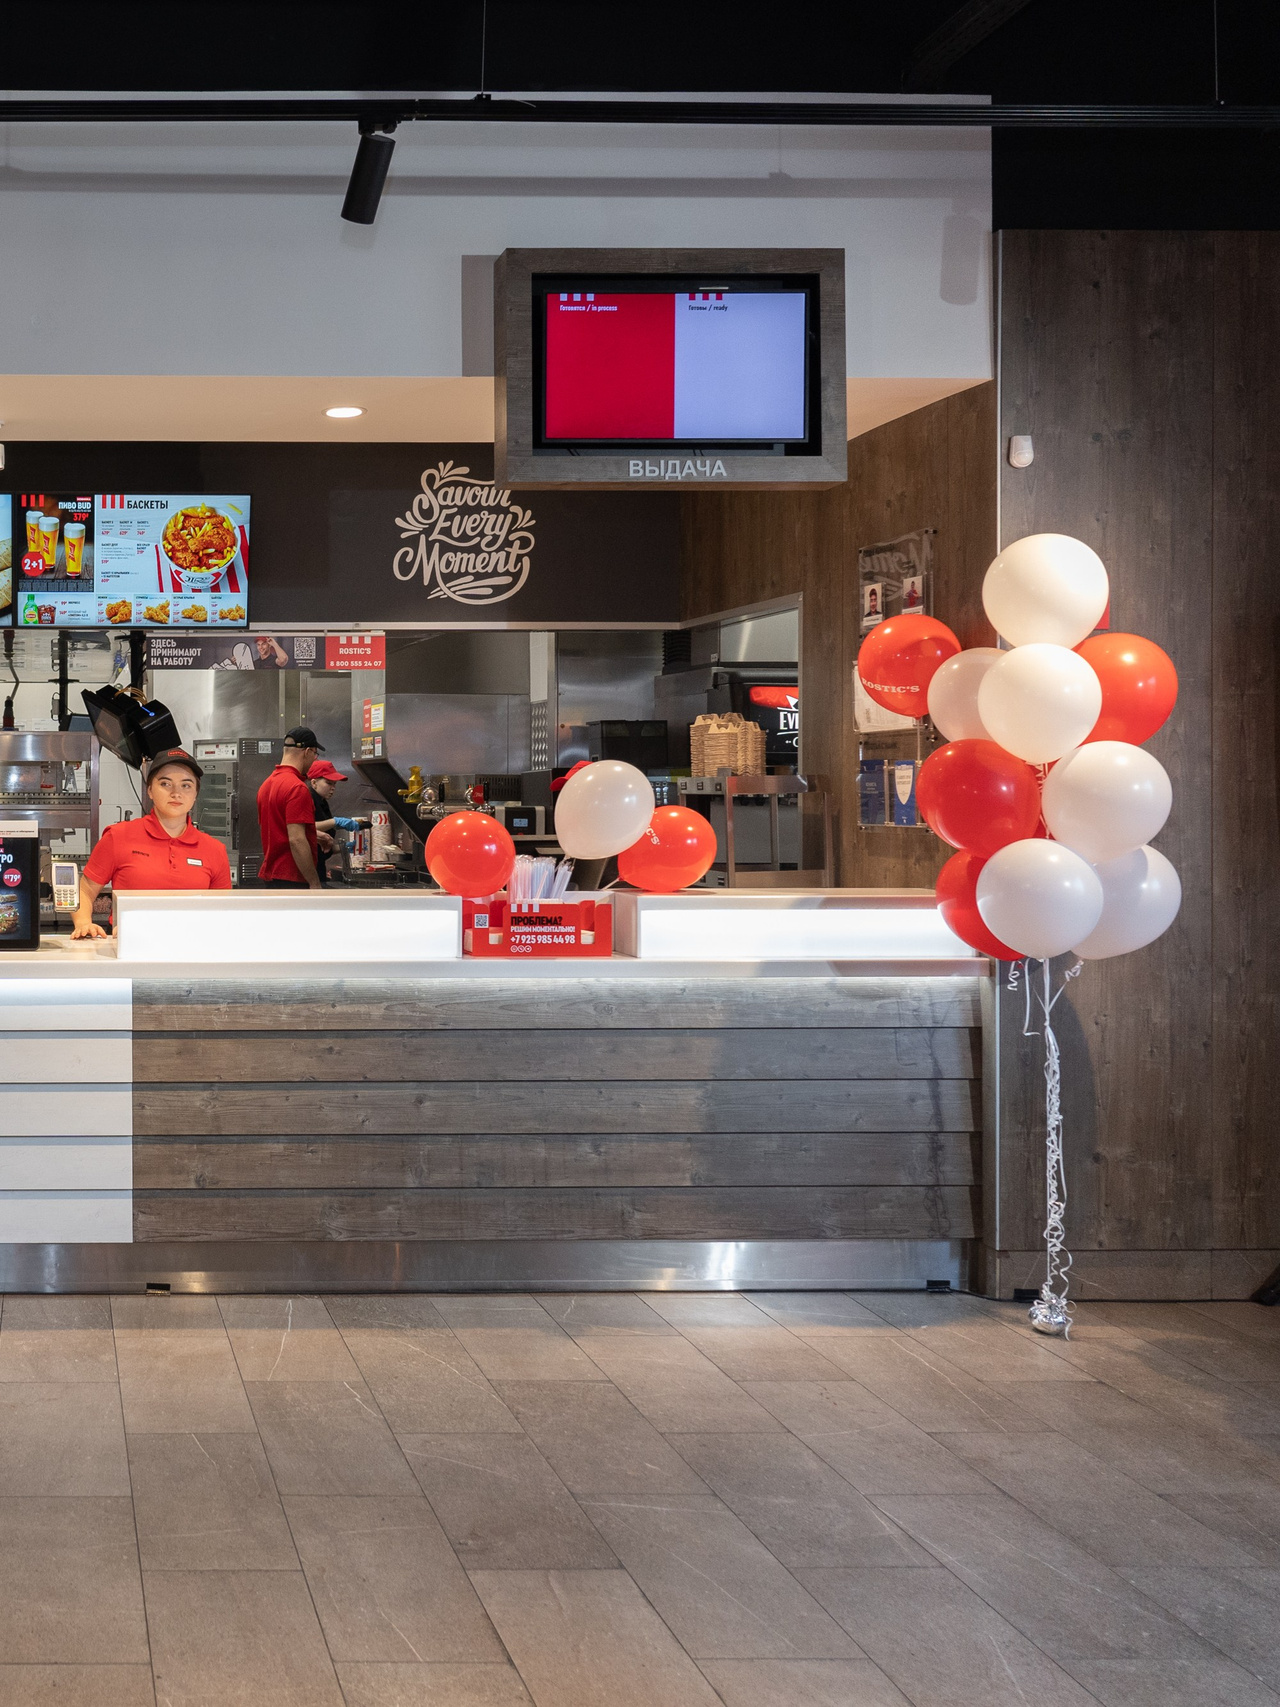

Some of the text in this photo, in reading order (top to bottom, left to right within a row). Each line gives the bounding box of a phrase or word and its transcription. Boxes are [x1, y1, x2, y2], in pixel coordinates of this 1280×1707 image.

[628, 459, 728, 480] ВЫДАЧА
[126, 500, 169, 509] БАСКЕТЫ
[428, 507, 514, 552] Every
[392, 532, 536, 587] Moment
[151, 639, 177, 648] ЗДЕСЬ
[151, 648, 202, 657] ПРИНИМАЮТ
[151, 657, 194, 666] НА РАБОТУ
[861, 677, 920, 693] ROSTIC'S
[510, 916, 563, 926] ПРОБЛЕМА?
[510, 935, 576, 944] +7 925 985 44 98
